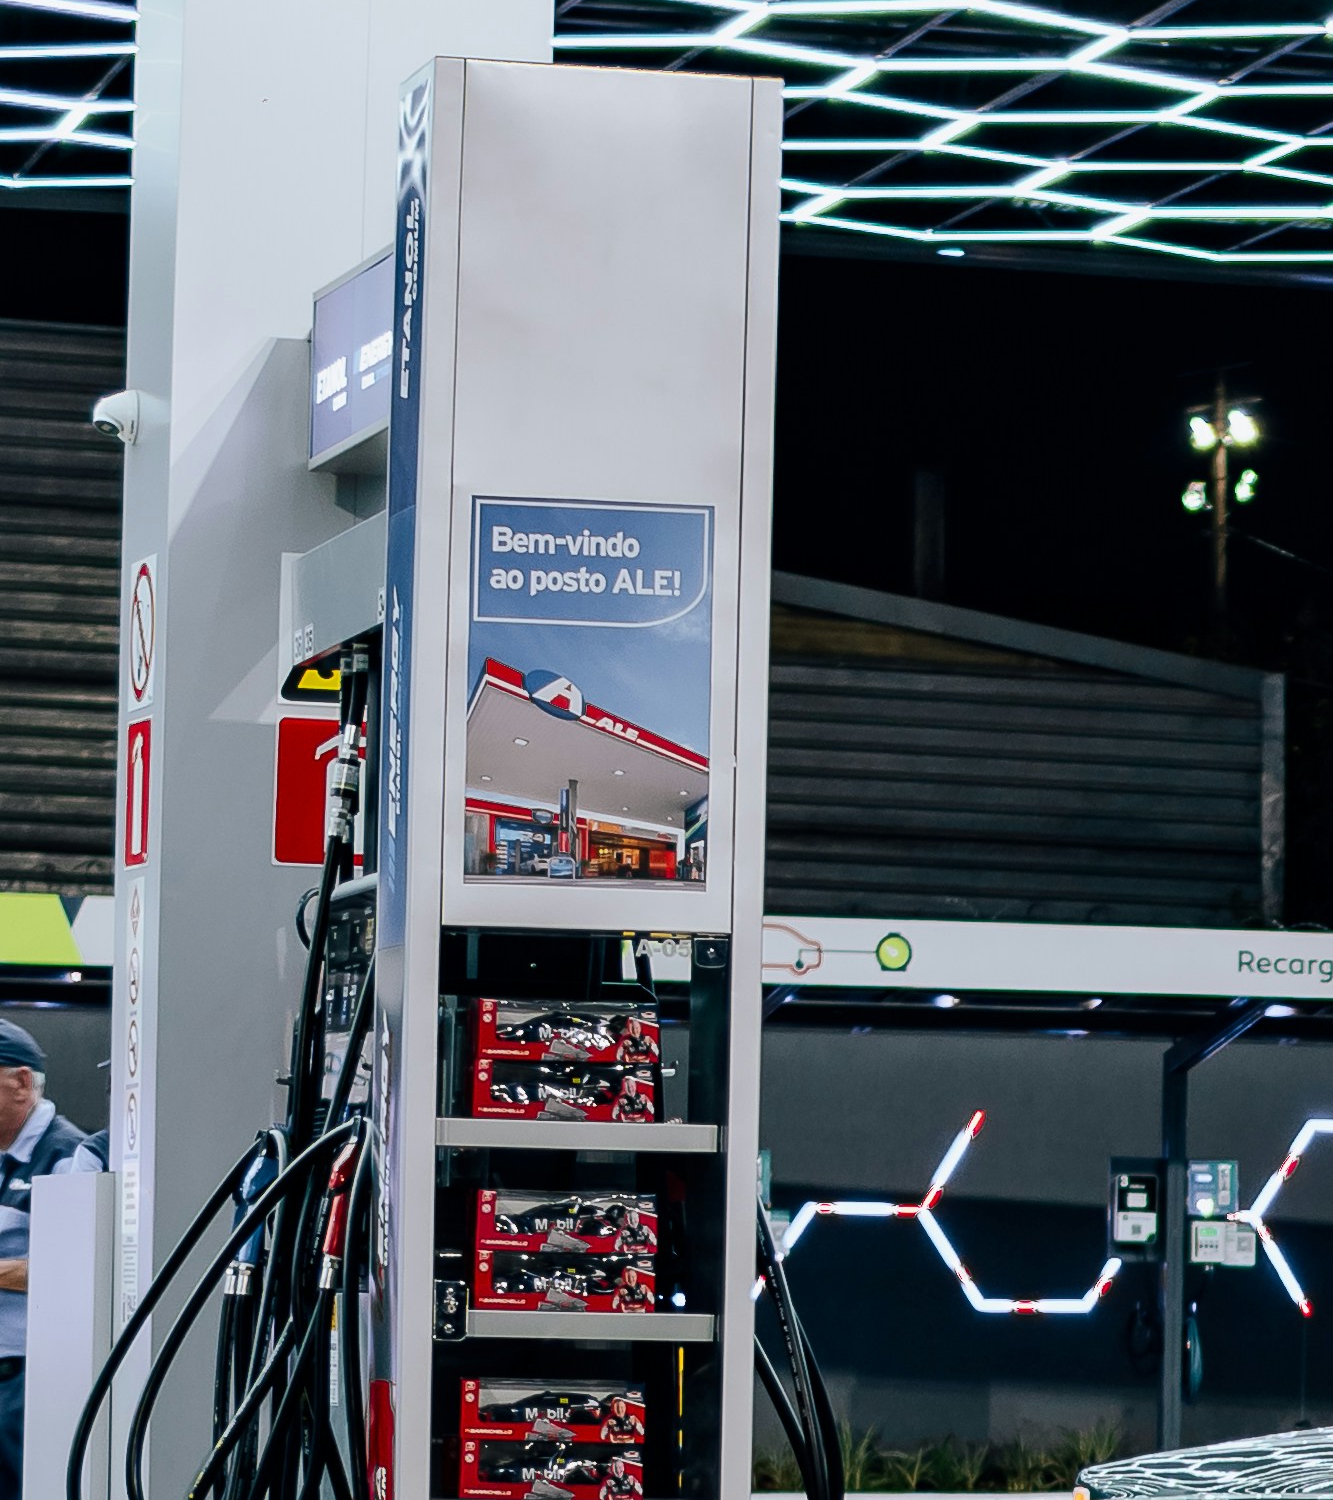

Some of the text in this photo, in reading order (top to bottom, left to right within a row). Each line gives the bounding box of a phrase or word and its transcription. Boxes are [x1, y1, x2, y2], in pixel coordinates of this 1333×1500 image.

[412, 198, 420, 300] COMUM
[401, 200, 415, 398] ETANOL
[492, 525, 641, 559] Bem-vindo
[489, 566, 681, 597] ao posto ALE!
[595, 716, 639, 741] ALE
[635, 938, 692, 958] A-05
